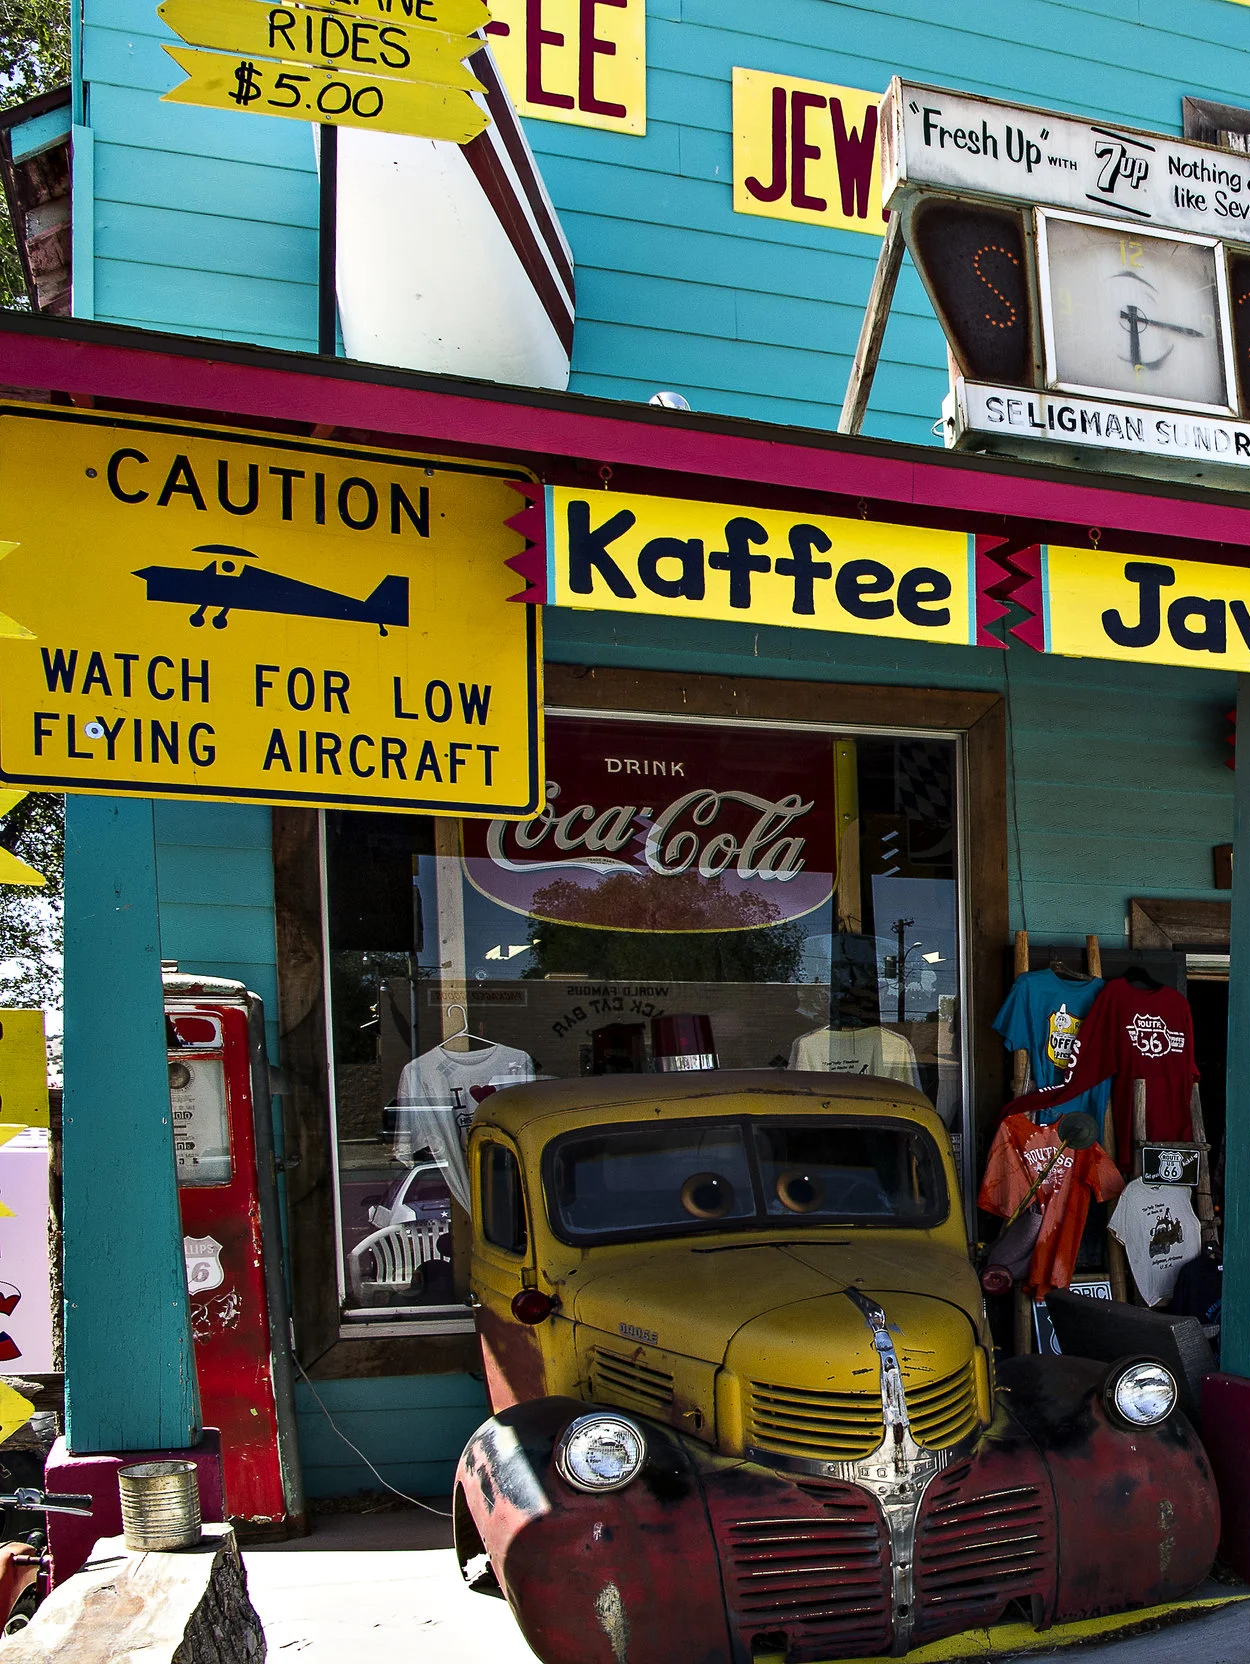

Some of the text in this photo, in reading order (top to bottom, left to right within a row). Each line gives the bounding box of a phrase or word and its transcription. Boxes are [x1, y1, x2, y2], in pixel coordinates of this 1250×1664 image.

[268, 9, 411, 69] RIDES
[228, 61, 384, 117] $5.00
[1048, 156, 1078, 172] WITH
[1167, 156, 1242, 192] Nothing
[1173, 184, 1208, 212] like
[986, 397, 1144, 443] SELIGMAN
[106, 447, 431, 538] CAUTION
[566, 500, 952, 627] Kaffee
[41, 647, 492, 726] WATCH FOR LOW
[34, 712, 500, 787] FLYING AIRCRAFT
[604, 758, 685, 777] DRINK
[1057, 1154, 1074, 1168] 66
[1164, 1167, 1178, 1178] 66
[861, 1461, 933, 1479] DOGE
